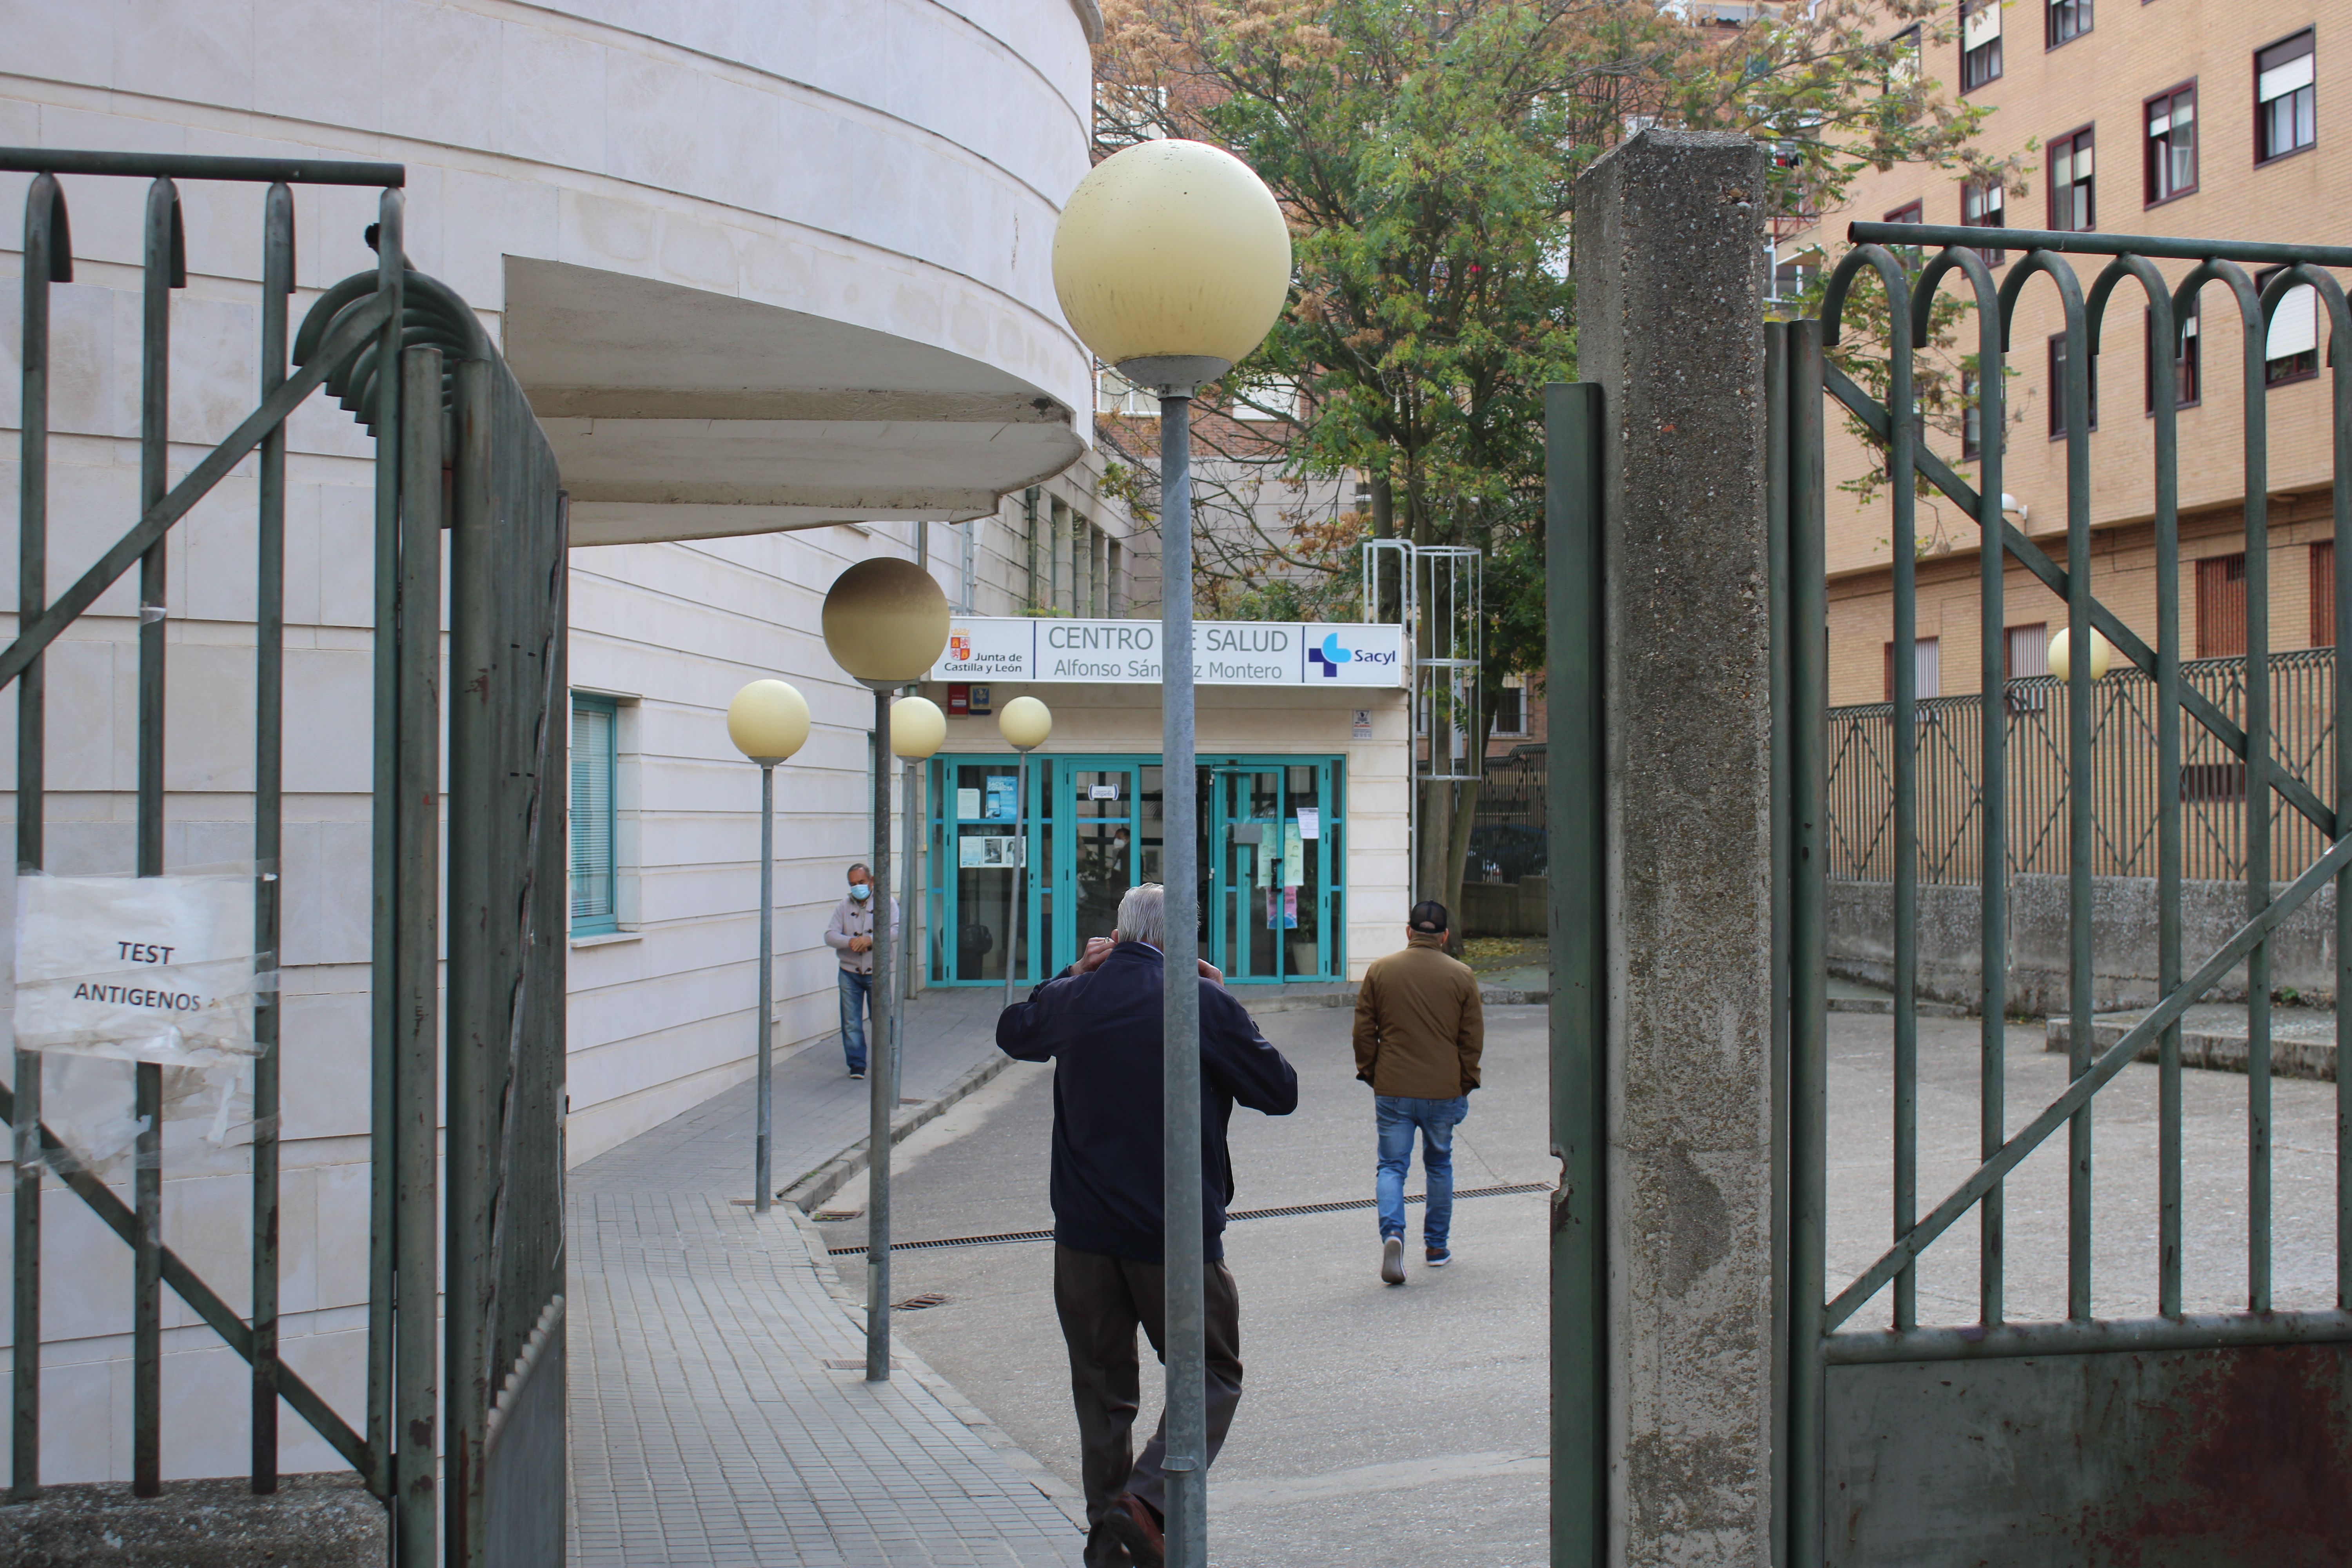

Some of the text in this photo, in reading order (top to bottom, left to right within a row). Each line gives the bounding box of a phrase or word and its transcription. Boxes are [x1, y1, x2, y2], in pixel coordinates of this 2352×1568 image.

[1049, 626, 1153, 650] CENTRO
[1206, 629, 1288, 652] SALUD
[975, 653, 1022, 661] Junta de
[1354, 649, 1396, 665] Sacyl
[944, 662, 1022, 674] Castilla y León
[1054, 659, 1282, 679] Alfonso Sánz Montero
[118, 941, 175, 965] TEST
[74, 982, 201, 1011] ANTIGENOS
